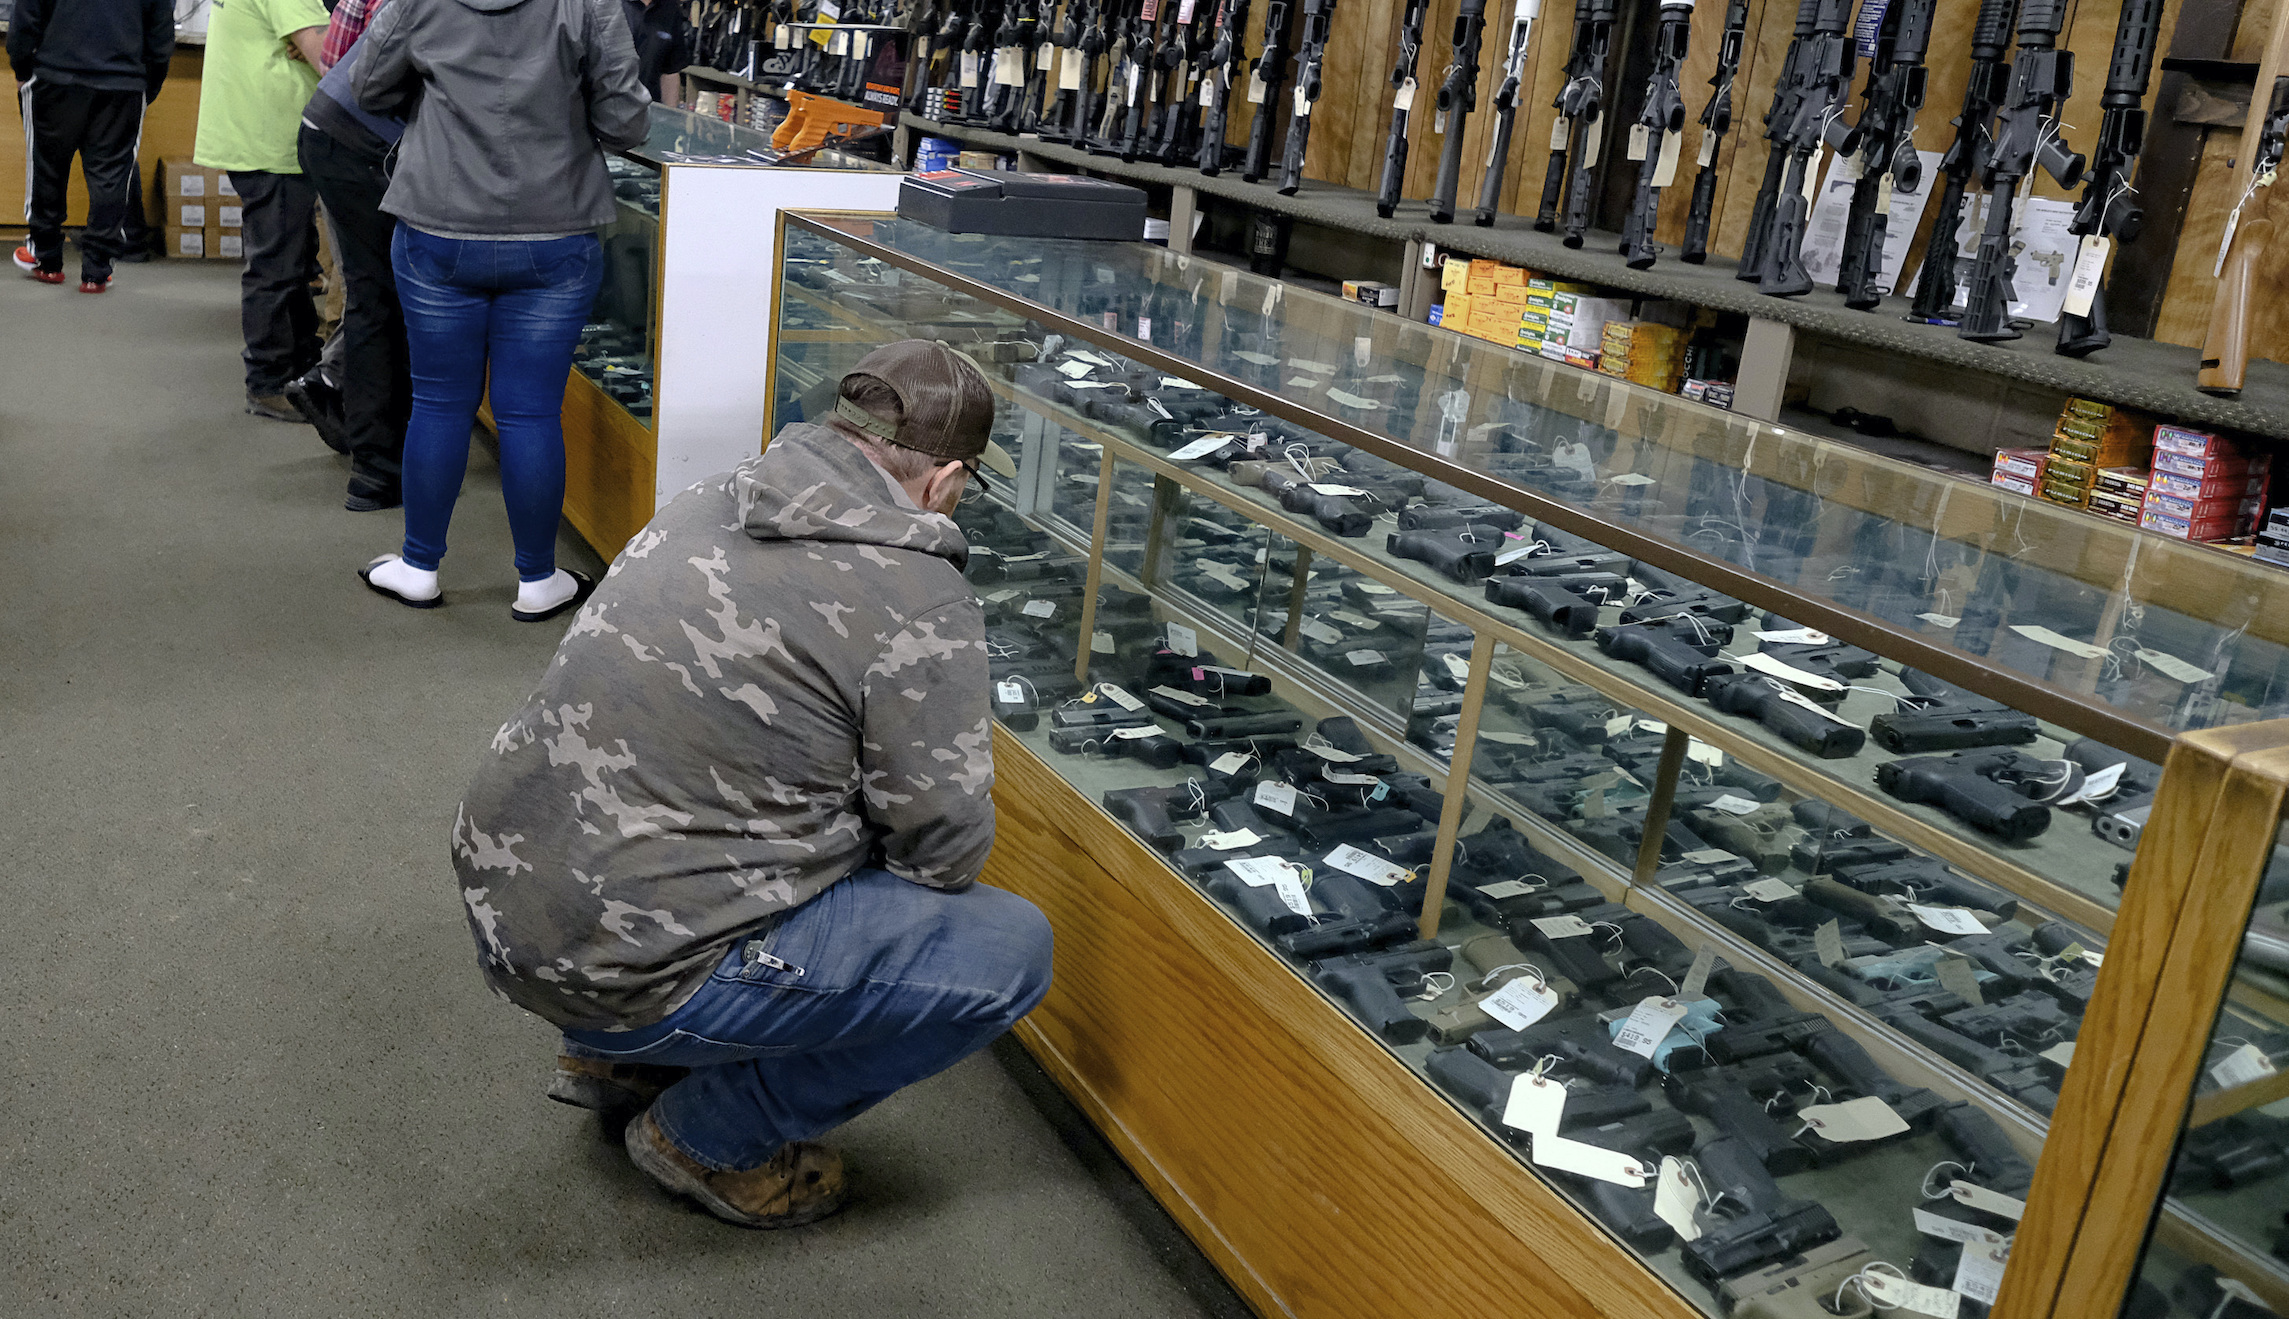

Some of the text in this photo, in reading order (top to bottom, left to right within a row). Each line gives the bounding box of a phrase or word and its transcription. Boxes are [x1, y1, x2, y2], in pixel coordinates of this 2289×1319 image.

[2062, 426, 2096, 438] FUSION
[2054, 447, 2088, 460] FUSION
[2048, 468, 2082, 480] FUSION
[2045, 487, 2080, 501] FUSION
[1620, 1031, 1652, 1045] $419.95
